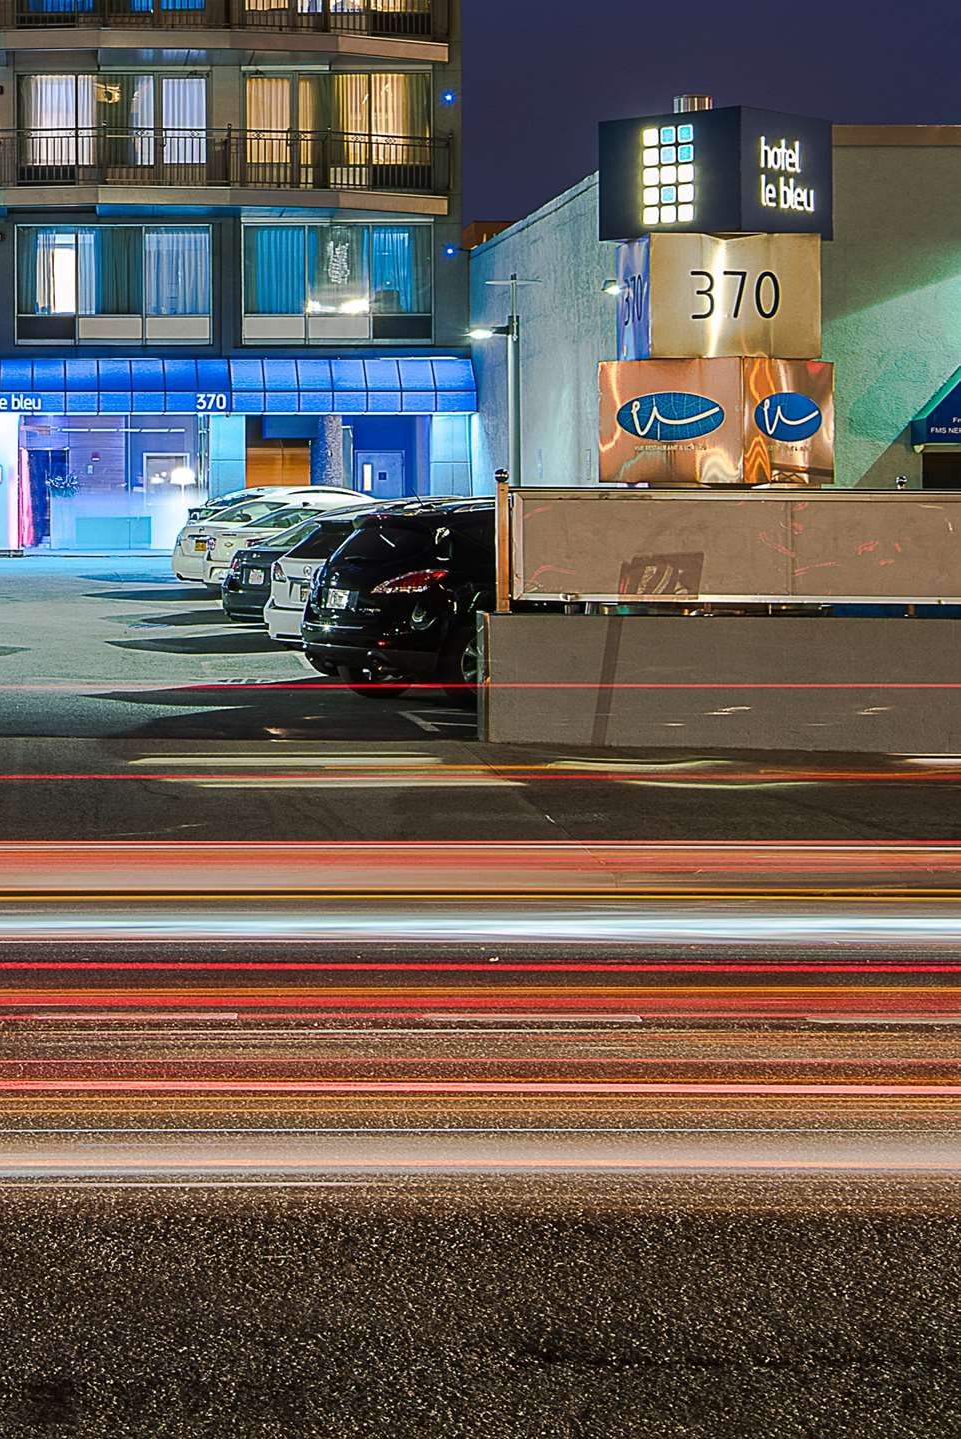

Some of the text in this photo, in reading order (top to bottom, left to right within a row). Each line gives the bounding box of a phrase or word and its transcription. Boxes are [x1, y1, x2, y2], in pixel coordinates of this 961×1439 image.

[759, 135, 802, 173] hotel
[760, 173, 815, 212] le bleu
[690, 270, 781, 320] 370
[10, 393, 42, 410] bleu
[195, 393, 227, 410] 370
